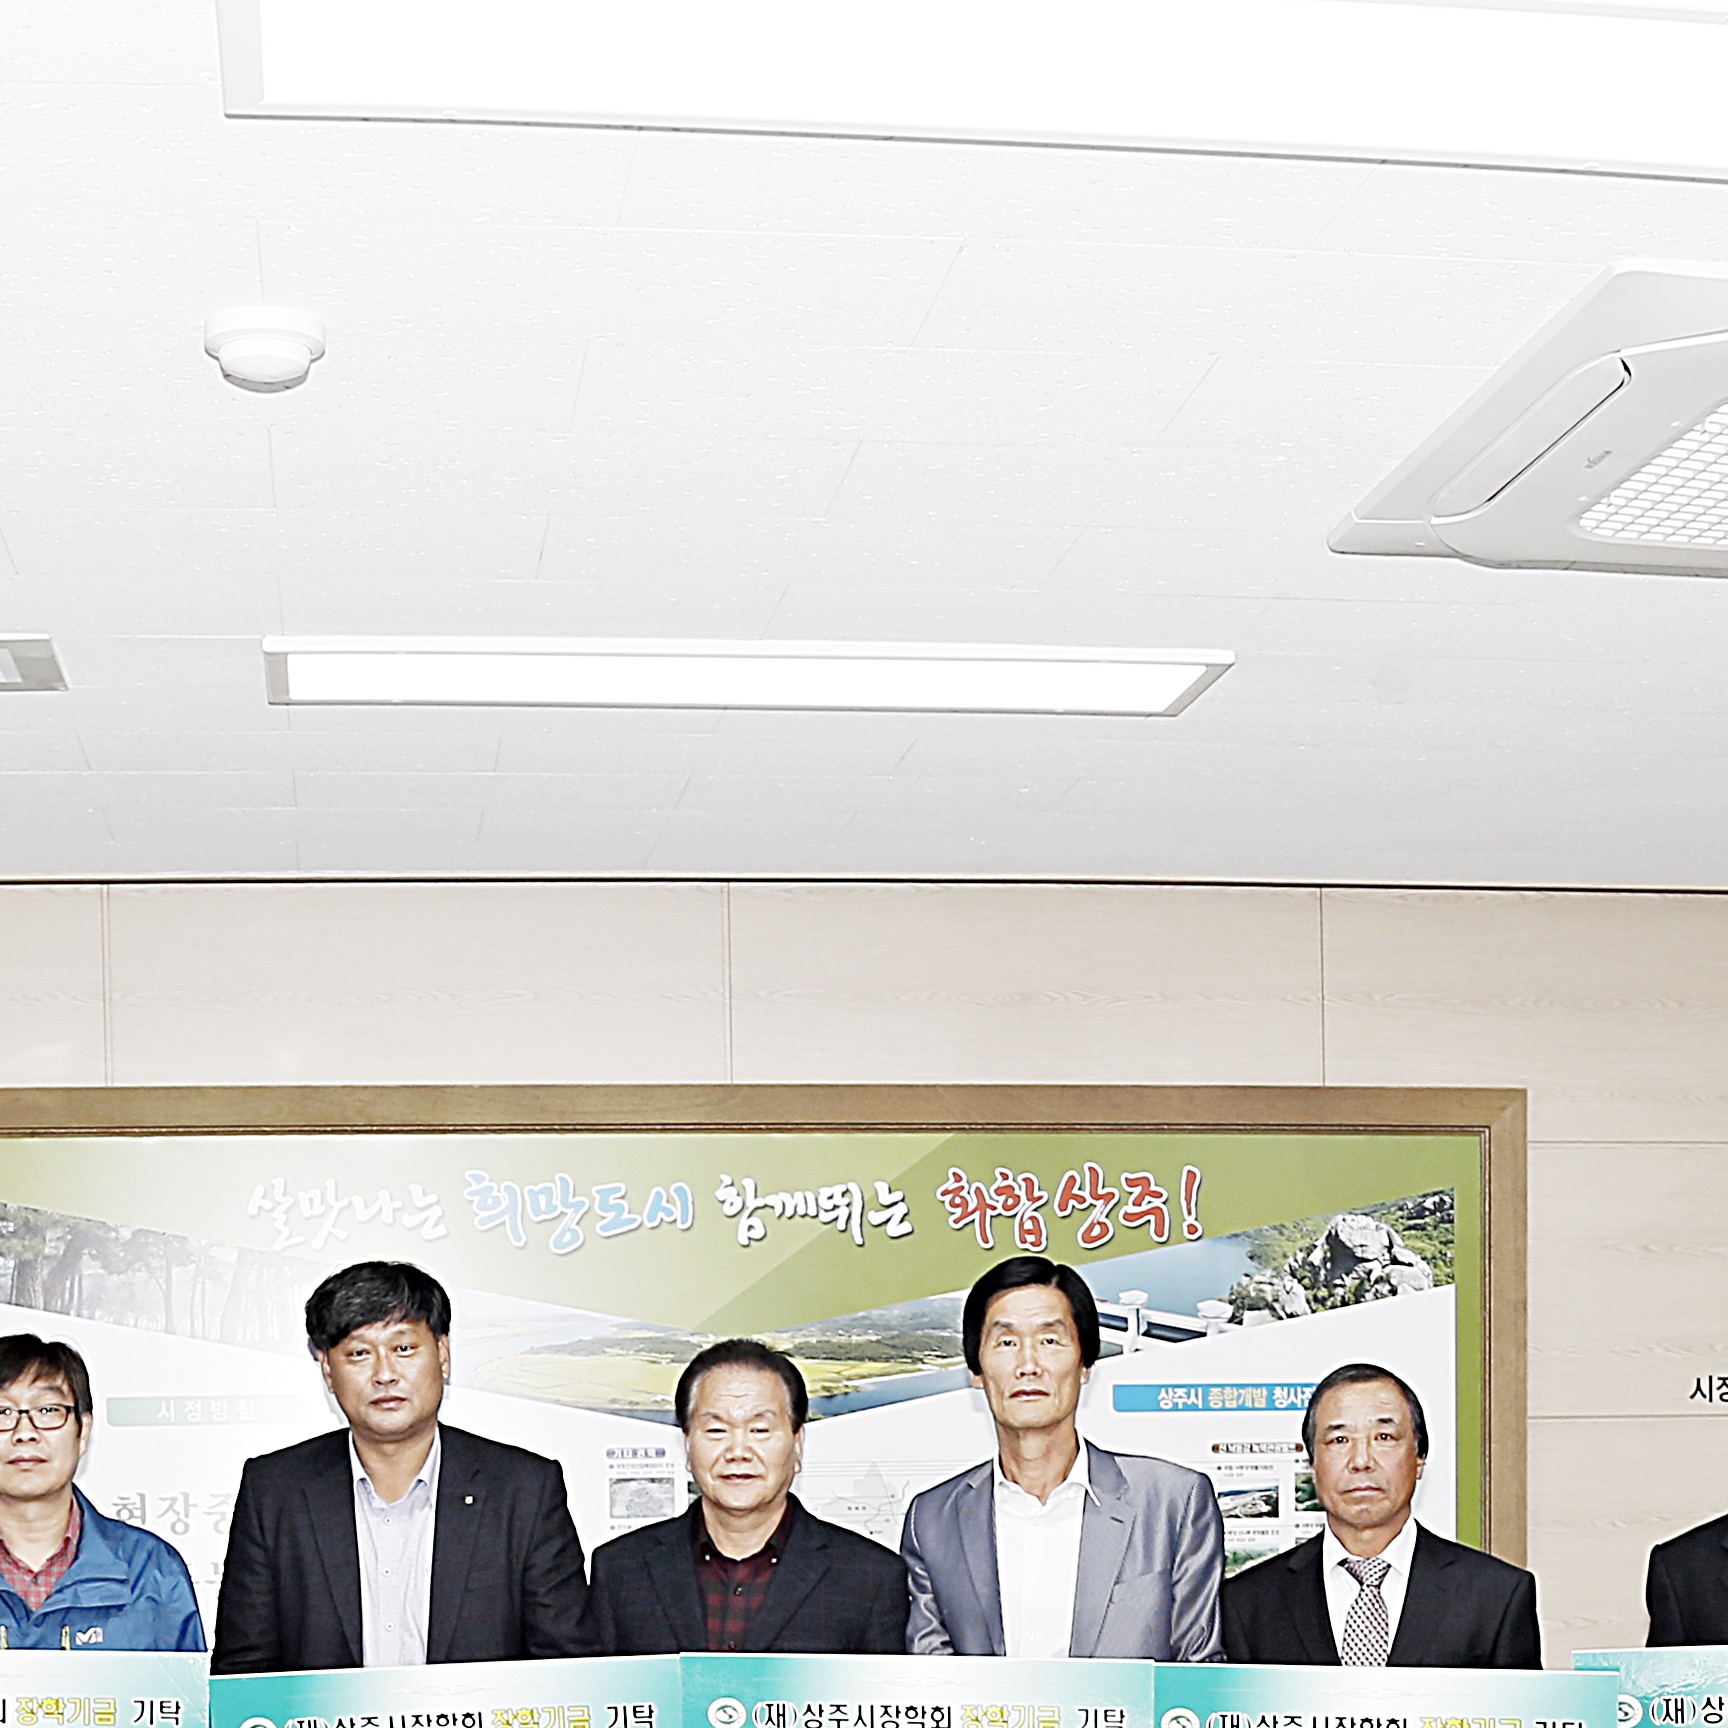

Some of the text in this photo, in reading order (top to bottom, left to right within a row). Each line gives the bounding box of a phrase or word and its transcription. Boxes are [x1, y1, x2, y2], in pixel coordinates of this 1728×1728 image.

[248, 1177, 449, 1251] 살맛나는
[464, 1169, 695, 1255] 희망도시
[715, 1173, 913, 1246] 함께뛰는
[1158, 1387, 1202, 1409] 상주시
[1208, 1387, 1267, 1408] 종합개발
[157, 1401, 255, 1421] 시정방침
[16, 1698, 117, 1725] 장학기금
[133, 1698, 181, 1725] 기탁
